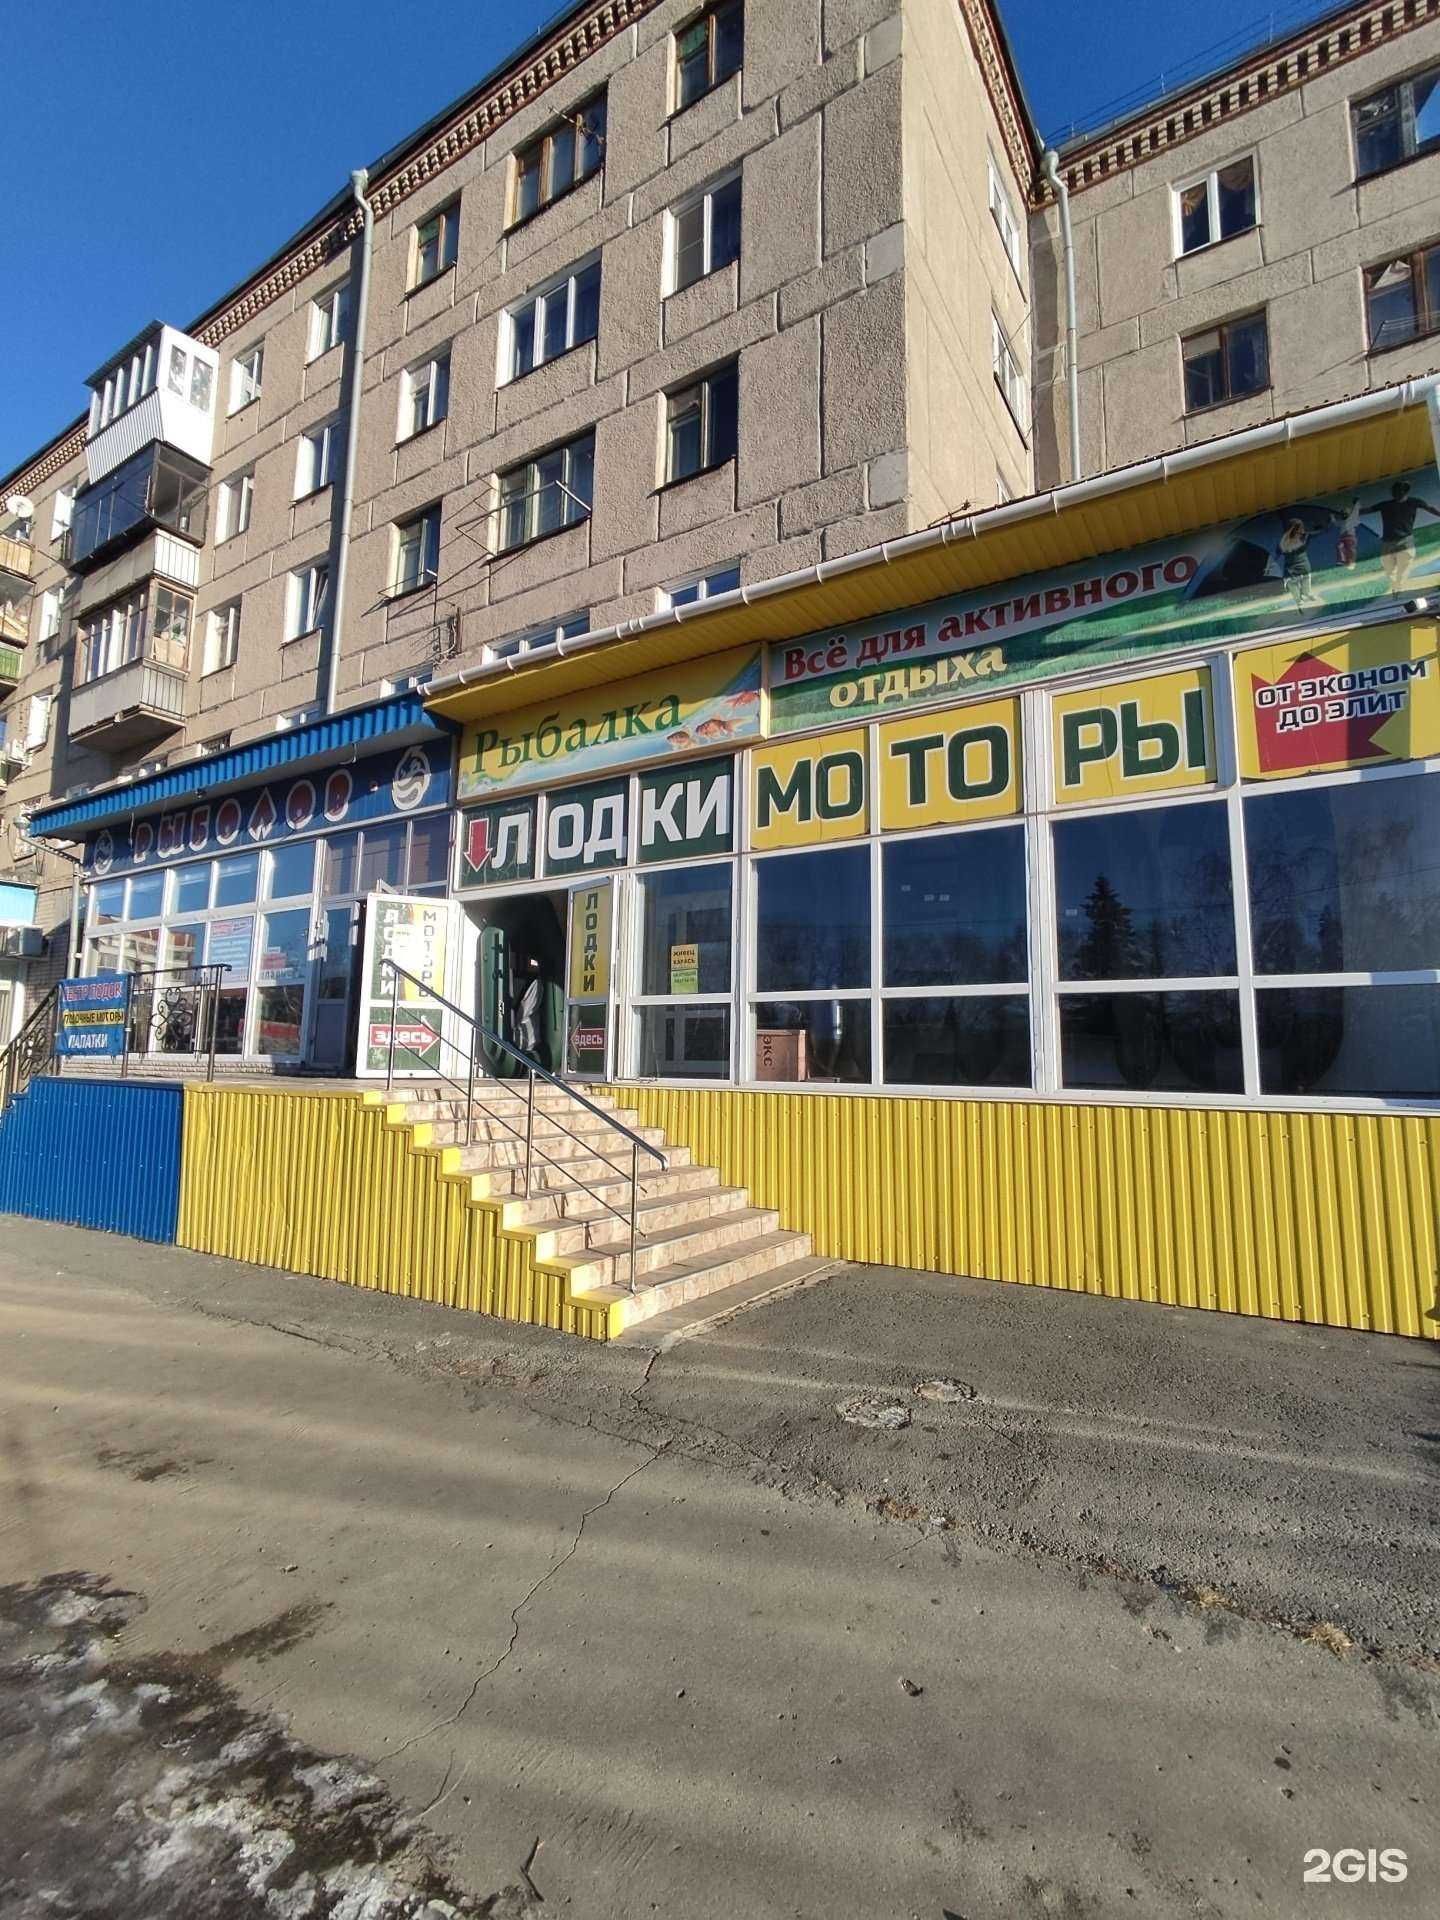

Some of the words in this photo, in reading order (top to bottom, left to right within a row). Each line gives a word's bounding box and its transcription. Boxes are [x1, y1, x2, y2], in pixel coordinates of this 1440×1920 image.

[783, 635, 848, 682] Всё
[856, 622, 927, 668] для
[937, 552, 1200, 645] активного
[828, 645, 1008, 709] отдыха
[1256, 682, 1296, 708] ОТ
[1299, 658, 1430, 701] ЭКОНОМ
[1276, 703, 1321, 733] ДО
[1325, 690, 1409, 722] ЭЛИТ
[472, 692, 685, 776] Рыбалка
[491, 774, 732, 870] ЛОДКИ
[583, 892, 599, 992] ЛОДКИ
